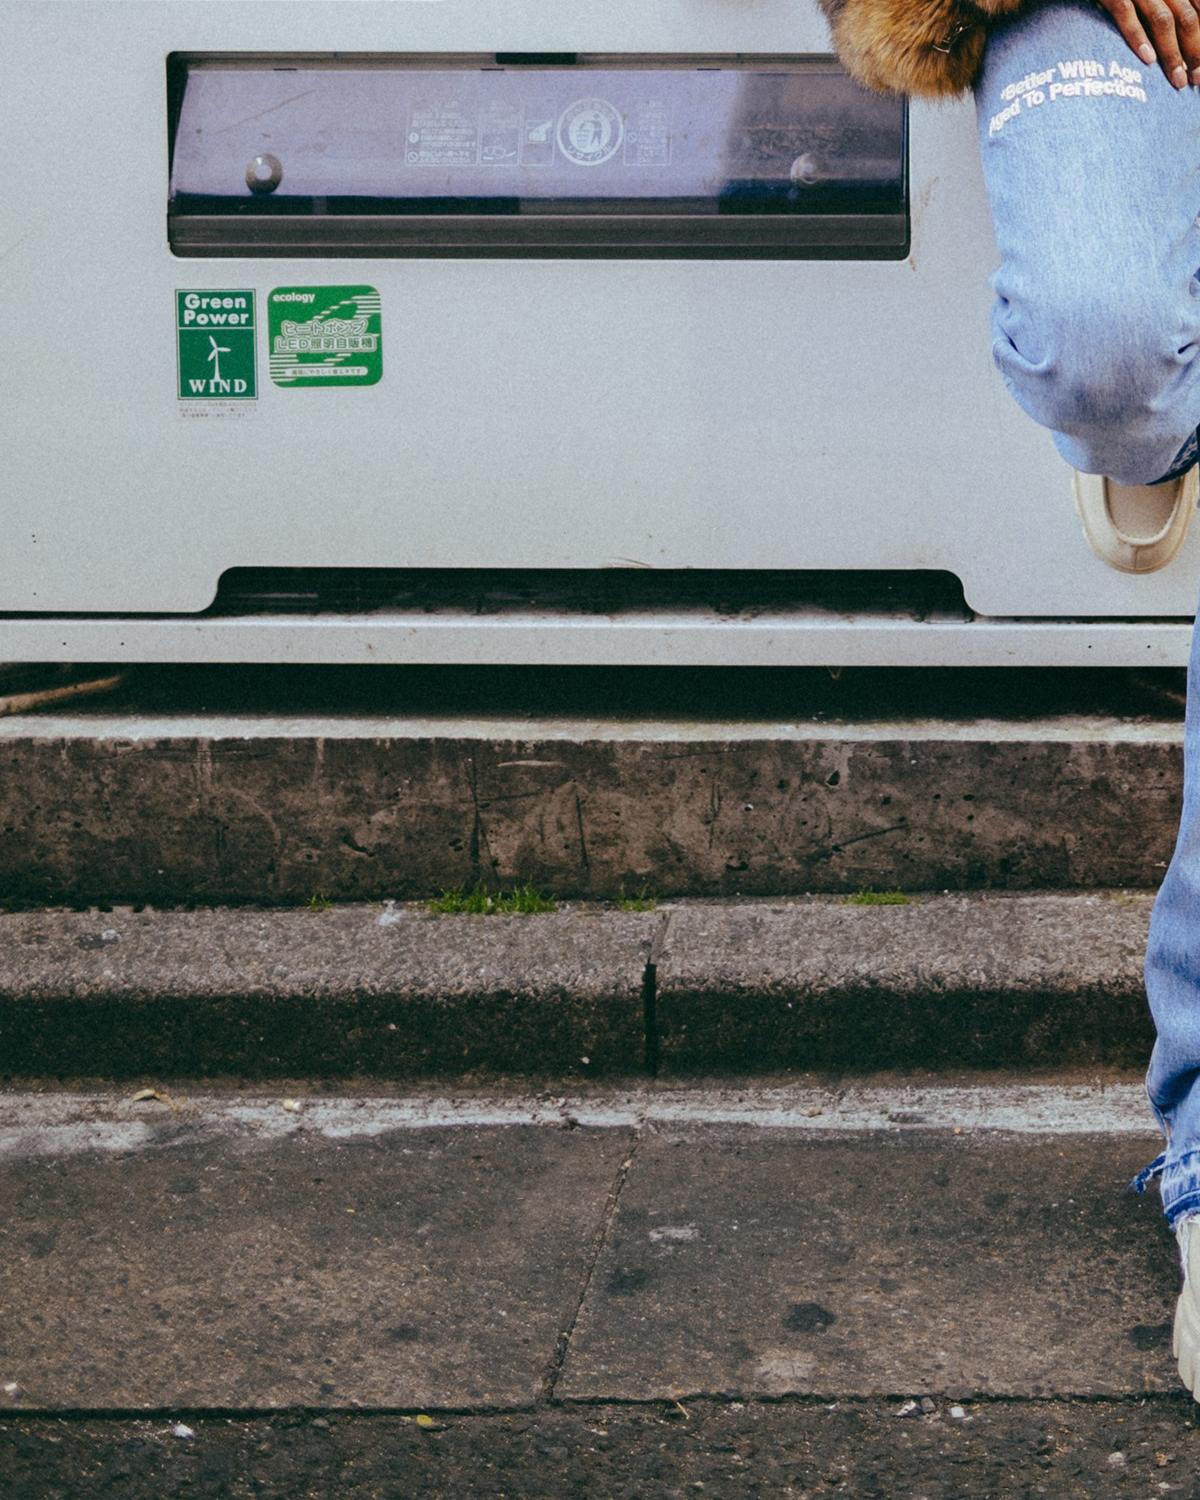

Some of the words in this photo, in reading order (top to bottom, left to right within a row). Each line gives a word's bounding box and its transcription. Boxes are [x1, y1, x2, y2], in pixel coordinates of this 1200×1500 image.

[1058, 60, 1104, 79] With
[1109, 61, 1142, 84] Age
[1022, 90, 1045, 108] To
[1049, 79, 1147, 103] Perfection
[185, 293, 247, 310] Green
[273, 293, 316, 303] ecology
[184, 310, 249, 326] Power
[282, 319, 368, 336] ヒートポンプ
[275, 336, 376, 351] LED照明自販機
[189, 379, 248, 393] WIND
